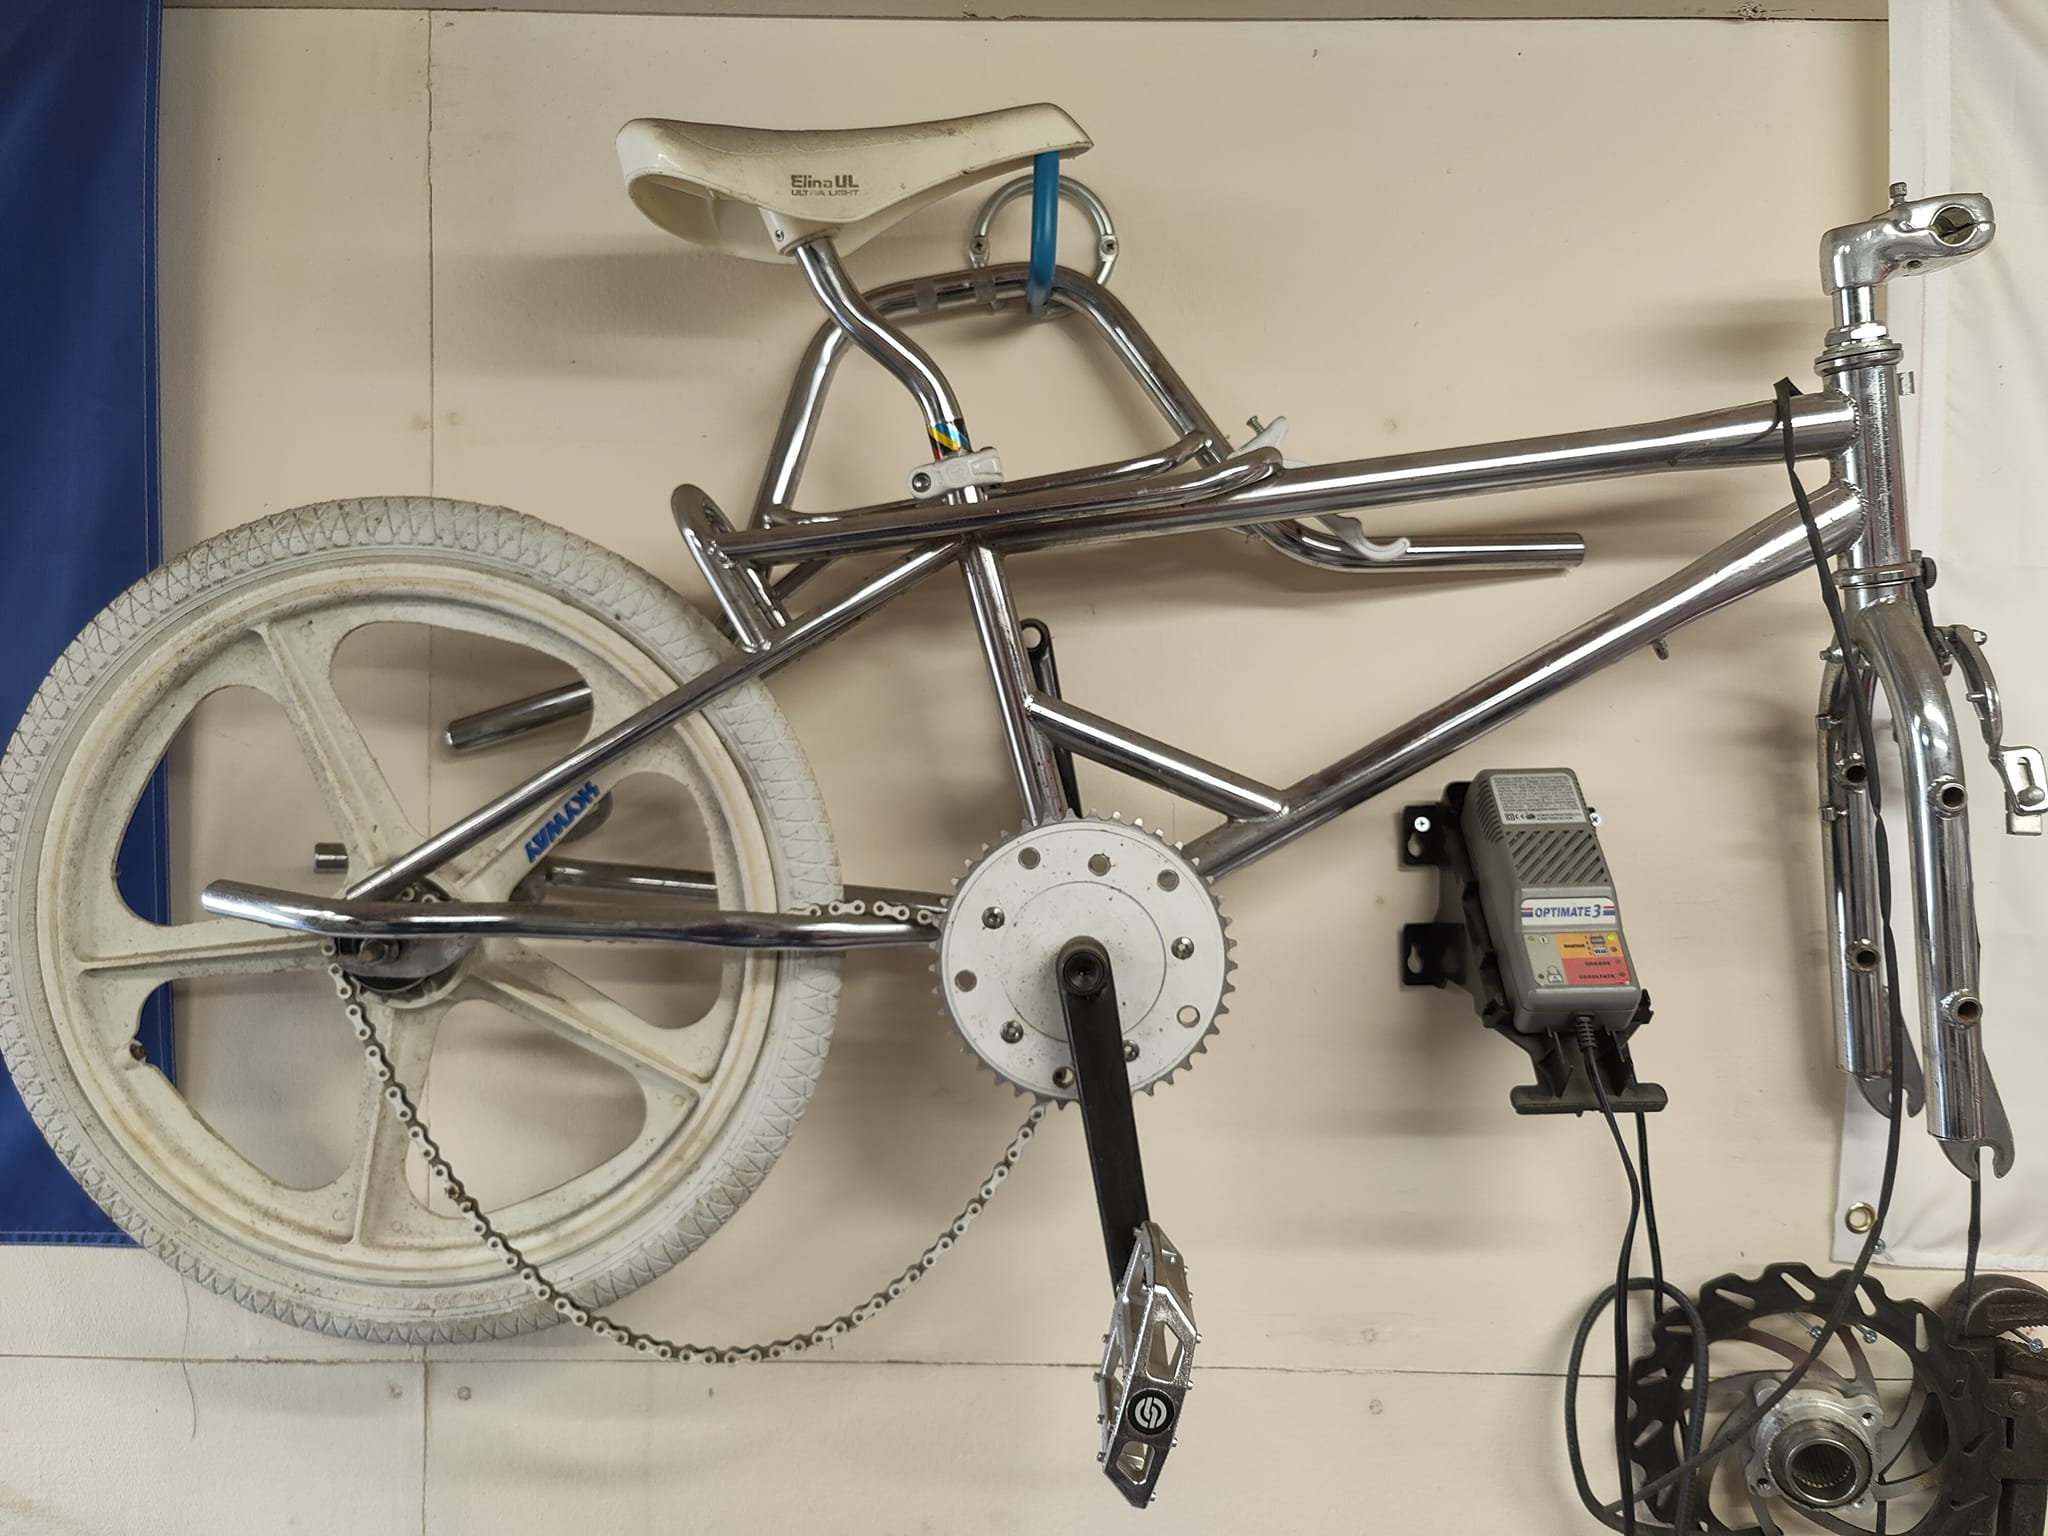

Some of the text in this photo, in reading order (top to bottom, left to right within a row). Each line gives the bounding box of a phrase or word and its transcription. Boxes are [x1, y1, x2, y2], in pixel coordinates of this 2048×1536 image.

[791, 174, 860, 188] Elina UL
[524, 780, 600, 864] SKYWAY
[1534, 904, 1602, 918] OPTIMATE 3
